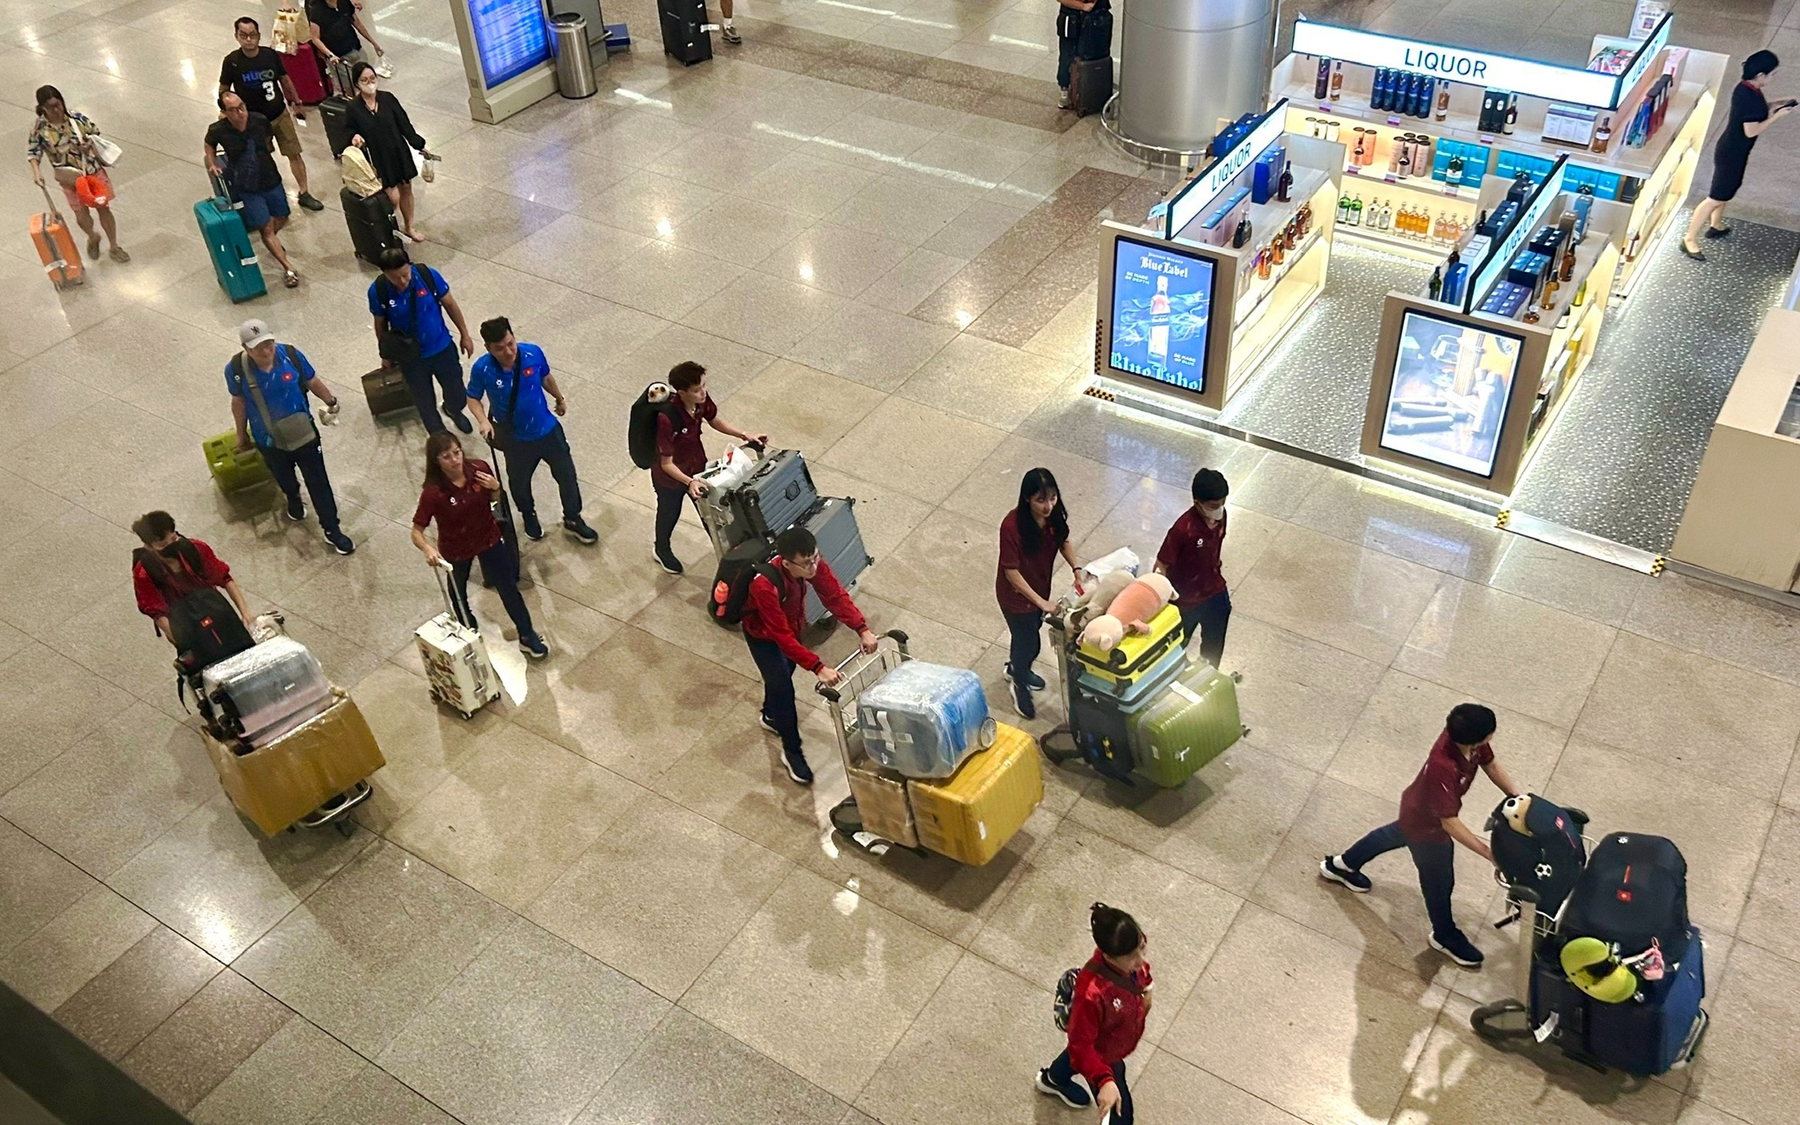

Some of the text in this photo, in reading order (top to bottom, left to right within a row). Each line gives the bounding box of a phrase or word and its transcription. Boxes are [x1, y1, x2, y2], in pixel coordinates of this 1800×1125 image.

[1404, 48, 1487, 79] LIQUOR
[262, 80, 276, 102] 3
[1211, 142, 1252, 193] LIQUOR
[1503, 204, 1538, 262] LIQUOR
[1140, 256, 1163, 271] Blue
[1162, 261, 1189, 278] Label
